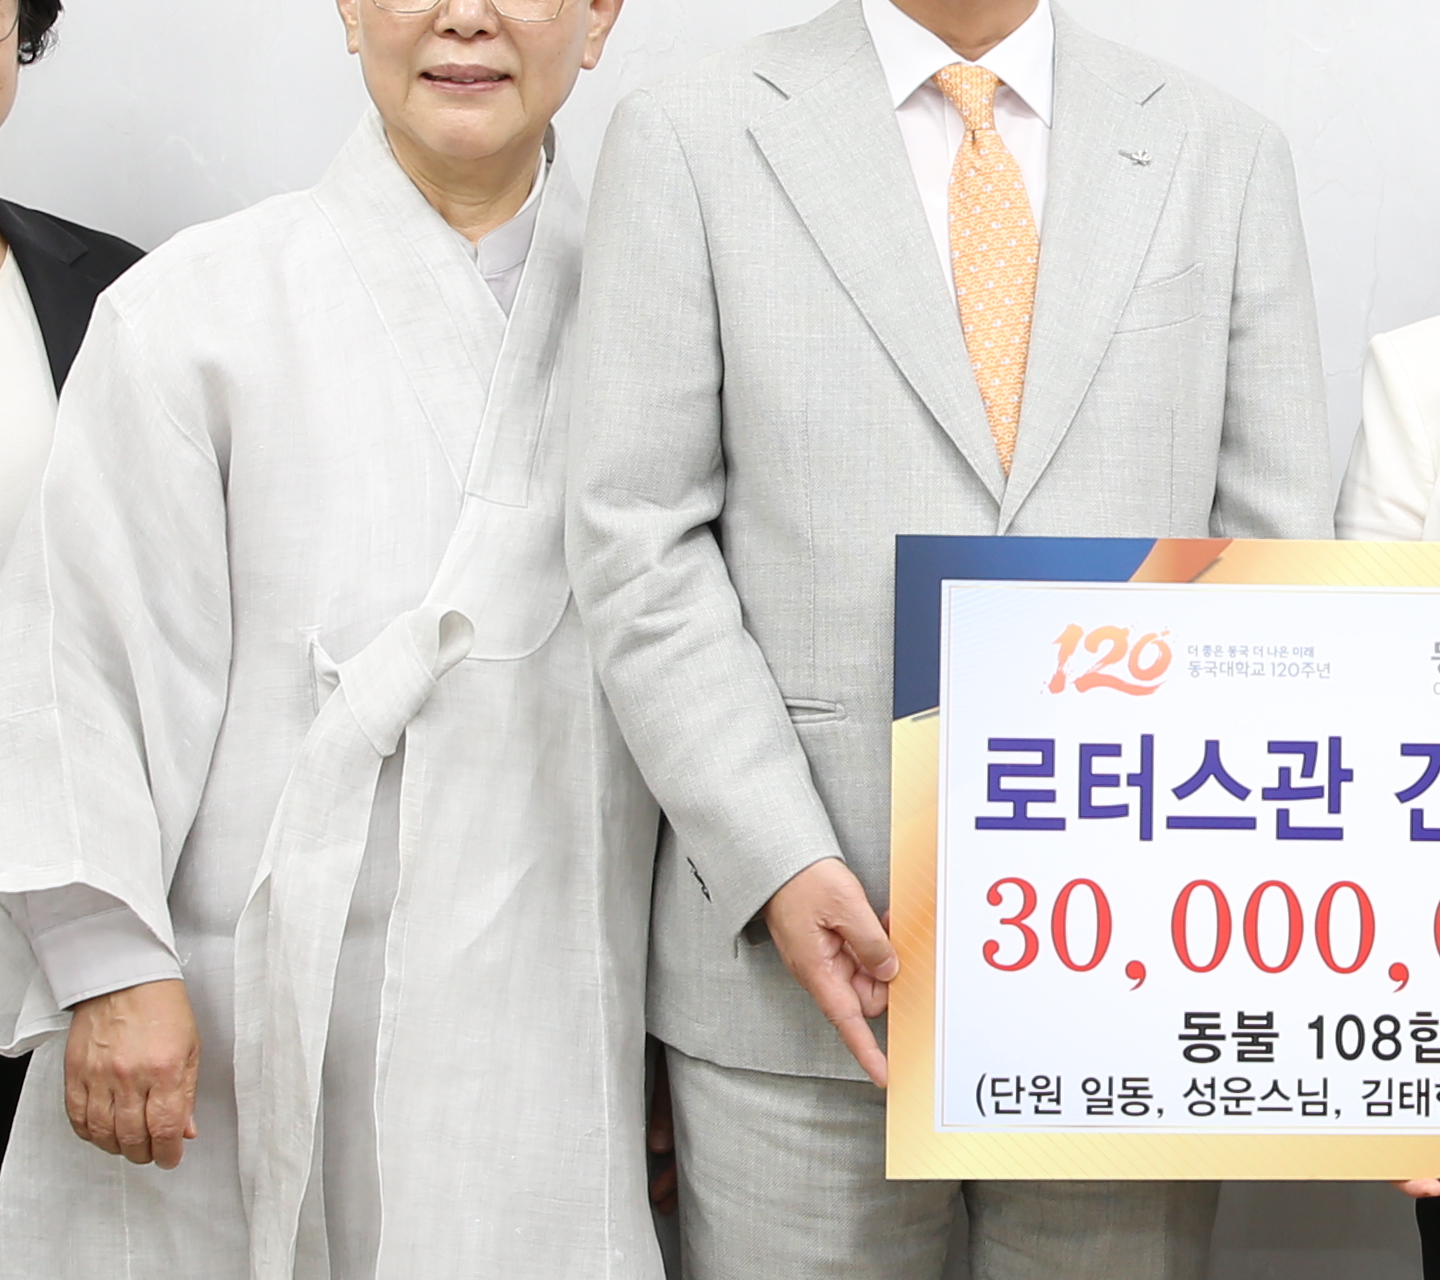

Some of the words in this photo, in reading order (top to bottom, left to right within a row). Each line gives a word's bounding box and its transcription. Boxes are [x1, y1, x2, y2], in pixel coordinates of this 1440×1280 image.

[1044, 624, 1172, 696] 120
[1188, 645, 1198, 657] 더
[1202, 645, 1224, 657] 좋은
[1227, 645, 1249, 658] 동국
[1253, 646, 1263, 657] 더
[1267, 646, 1289, 658] 나은
[1293, 646, 1314, 658] 미래
[1188, 661, 1265, 678] 동국대학교
[1271, 662, 1330, 679] 120주년
[975, 734, 1354, 841] 로터스관
[1178, 1011, 1279, 1063] 동불
[976, 1074, 1061, 1117] (단원
[1082, 1076, 1163, 1118] 일동,
[1183, 1077, 1341, 1118] 성운스님,
